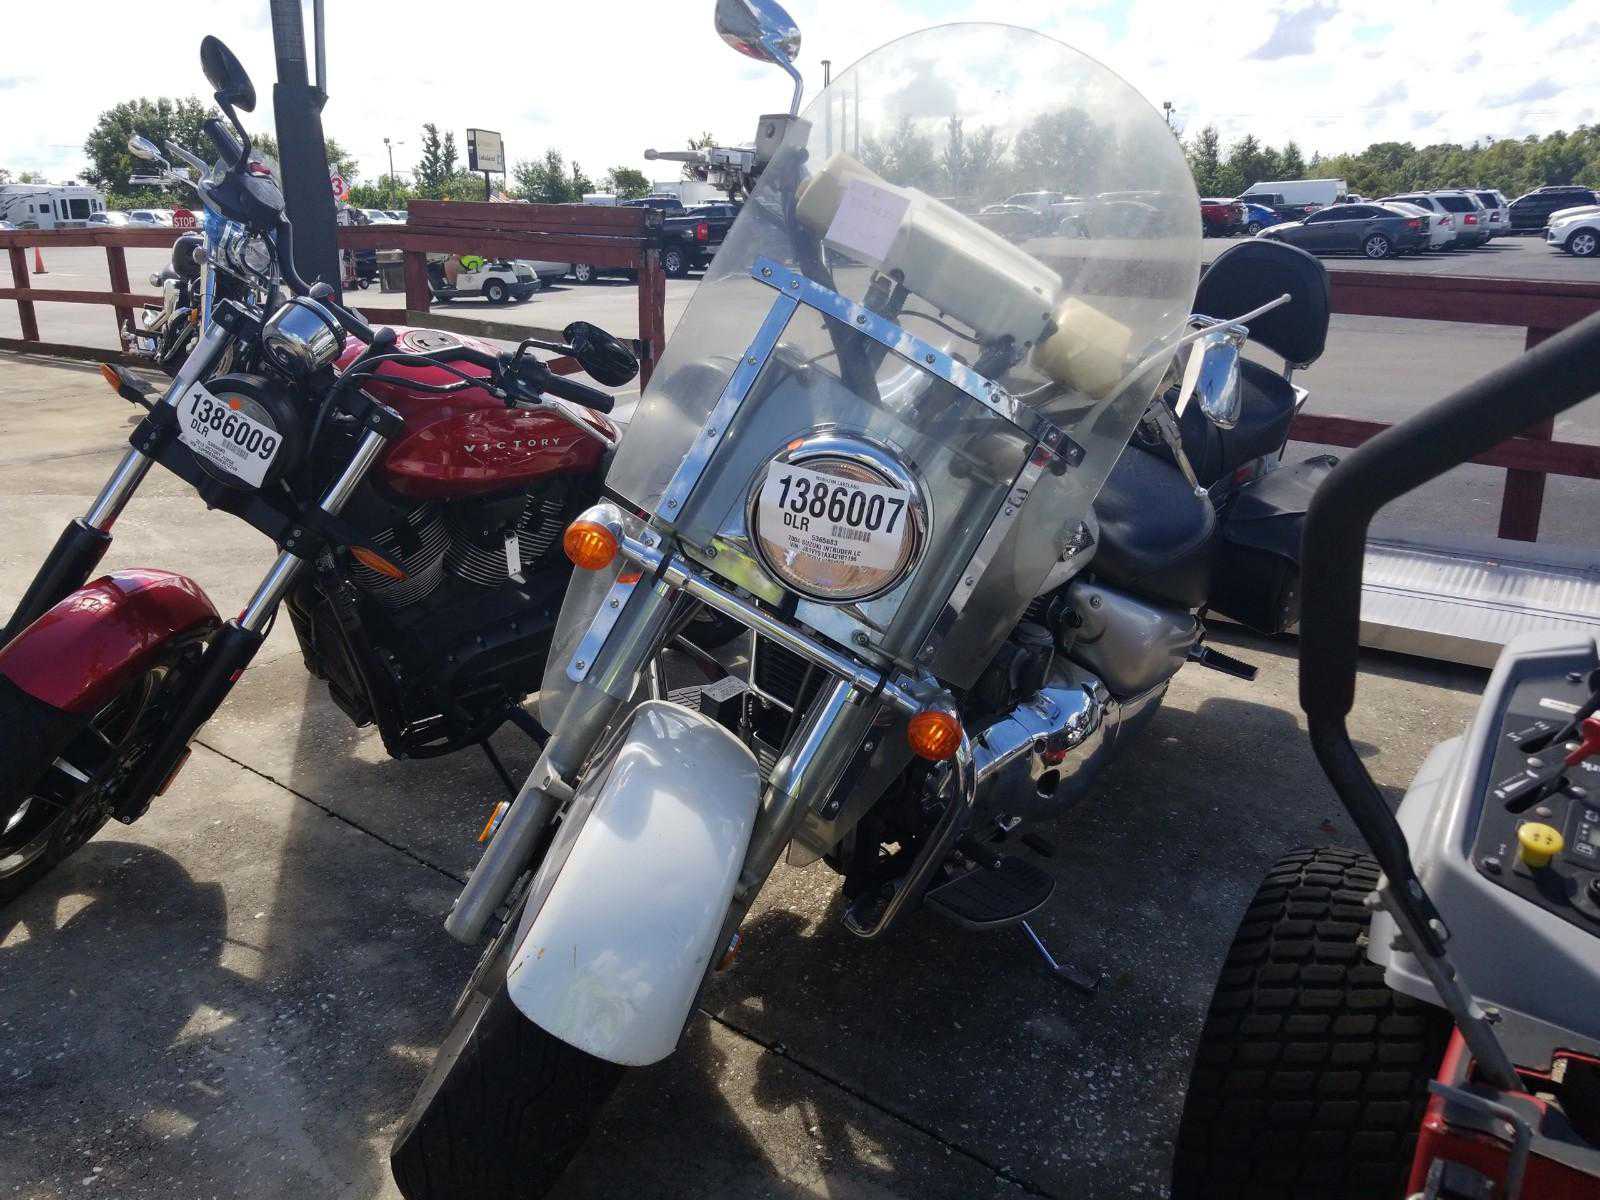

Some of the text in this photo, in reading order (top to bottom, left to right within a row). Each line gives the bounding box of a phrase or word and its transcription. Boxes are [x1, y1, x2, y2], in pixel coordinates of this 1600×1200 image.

[174, 217, 195, 227] STOP
[189, 393, 277, 460] 1386009
[190, 418, 210, 438] DLR
[463, 437, 560, 453] VICTORY
[778, 474, 905, 534] 1386007
[783, 512, 810, 532] DLR
[822, 546, 852, 556] INTRUDER
